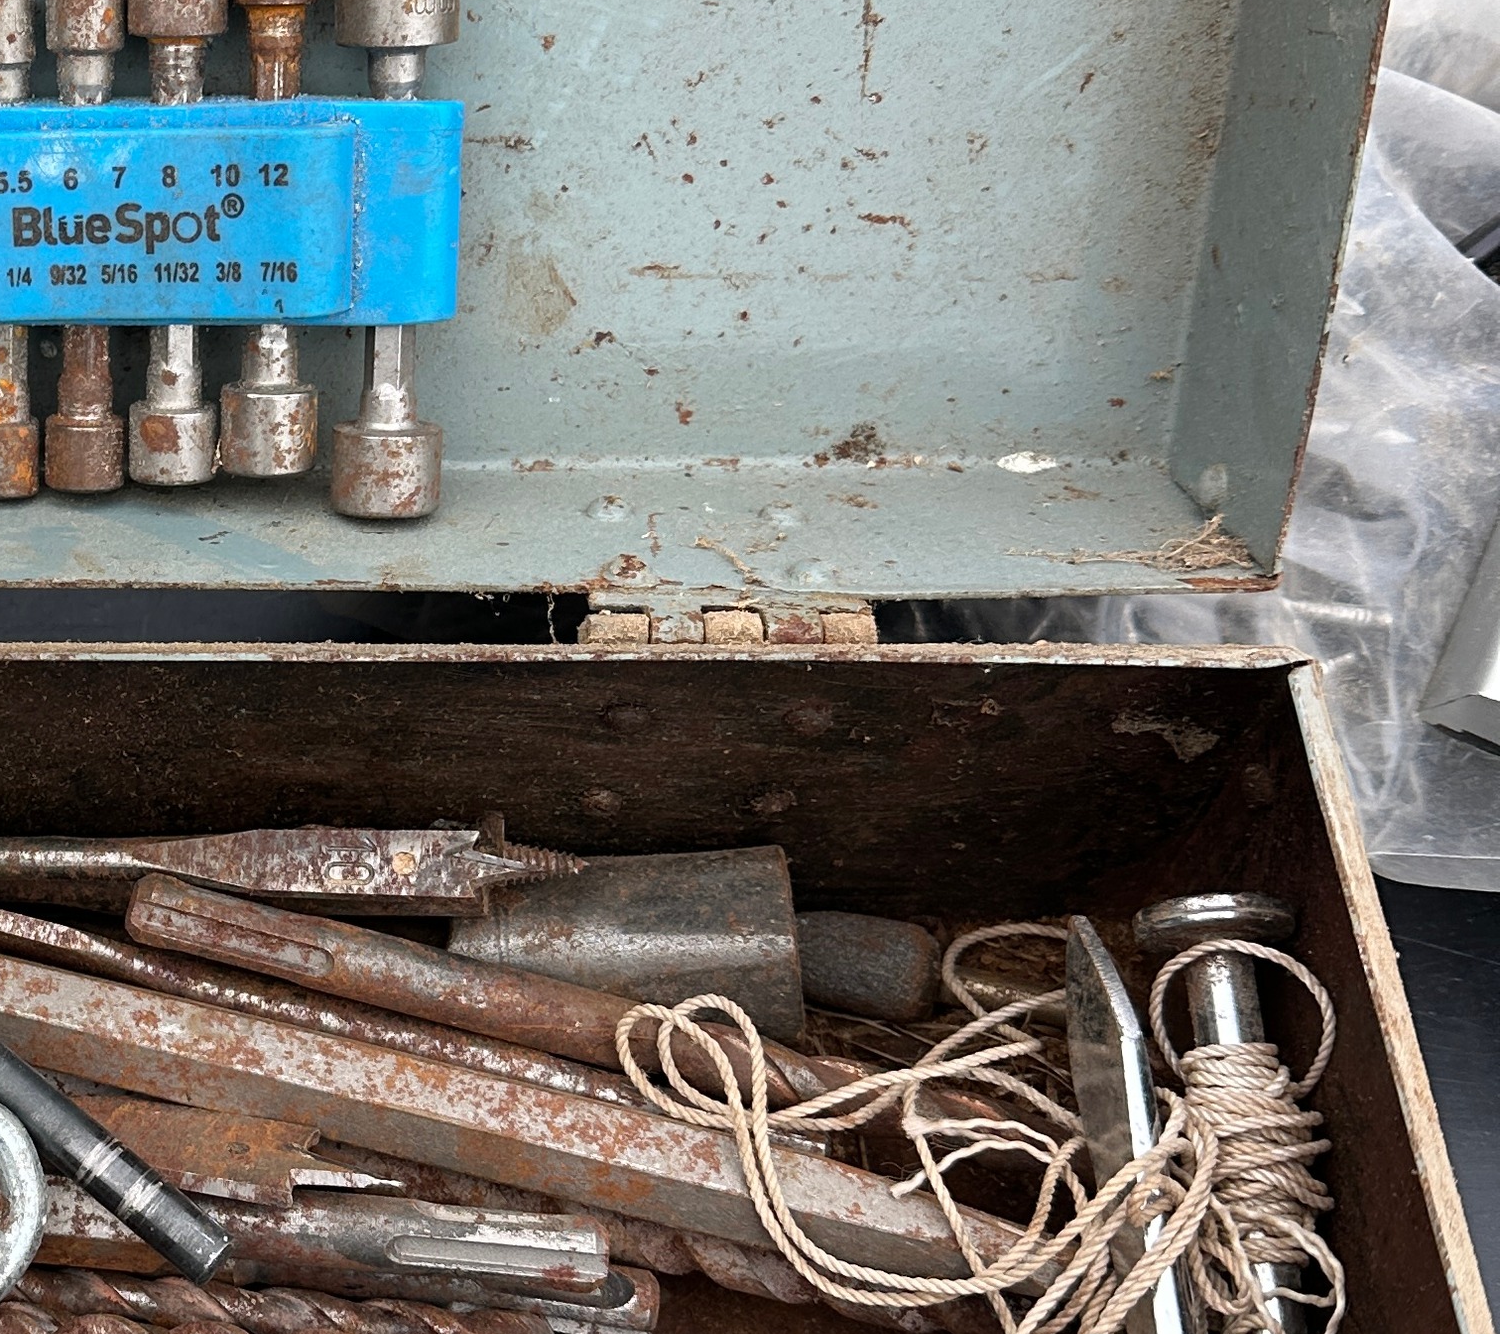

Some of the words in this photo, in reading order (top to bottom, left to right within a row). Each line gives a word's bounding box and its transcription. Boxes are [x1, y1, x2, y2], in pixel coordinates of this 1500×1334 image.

[63, 167, 79, 191] 6
[111, 166, 127, 189] 7
[162, 165, 177, 188] 8
[210, 164, 241, 187] 10
[258, 163, 289, 187] 12
[6, 267, 32, 287] 1/4
[50, 264, 87, 286] 9/32
[101, 263, 138, 284] 5/16
[154, 262, 199, 283] 11/32
[215, 261, 242, 283] 3/8
[260, 261, 298, 283] 7/16
